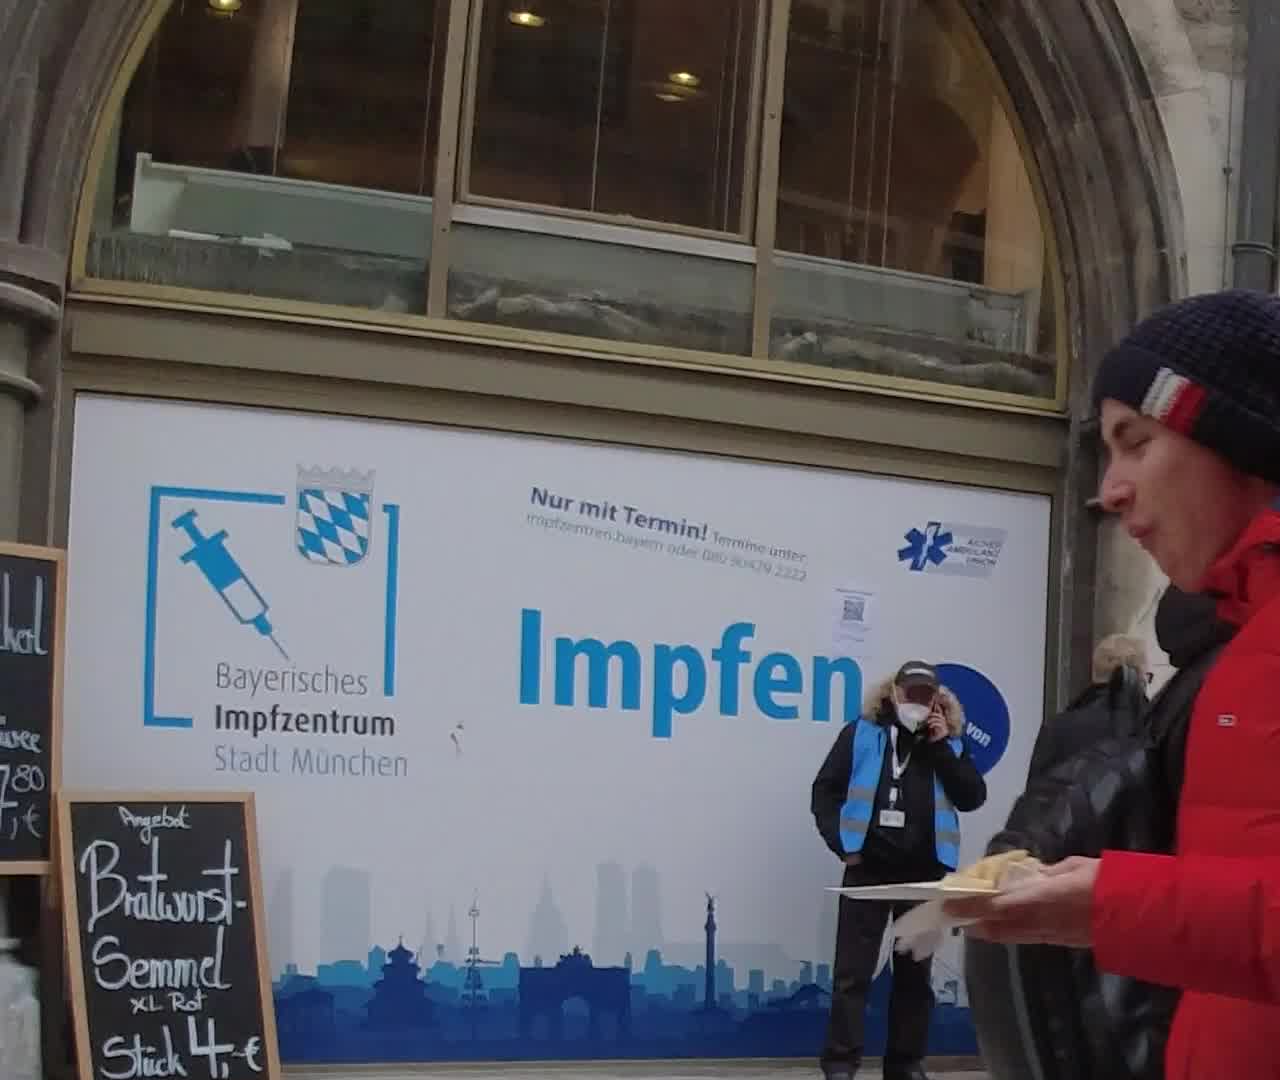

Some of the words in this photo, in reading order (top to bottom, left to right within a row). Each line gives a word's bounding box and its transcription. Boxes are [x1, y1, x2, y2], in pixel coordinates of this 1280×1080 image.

[530, 486, 573, 512] Nur
[579, 500, 617, 522] mit
[623, 506, 708, 541] Termin!
[713, 530, 766, 554] Termine
[769, 547, 806, 562] unter
[215, 662, 369, 698] Bayerisches
[519, 608, 864, 738] Impfen
[215, 703, 395, 738] Impfzentrum
[214, 744, 280, 774] Stadt
[291, 746, 408, 777] München
[118, 804, 192, 845] Angebot
[92, 925, 232, 990] Semmel
[168, 991, 207, 1012] Rot
[100, 1024, 188, 1079] Stück
